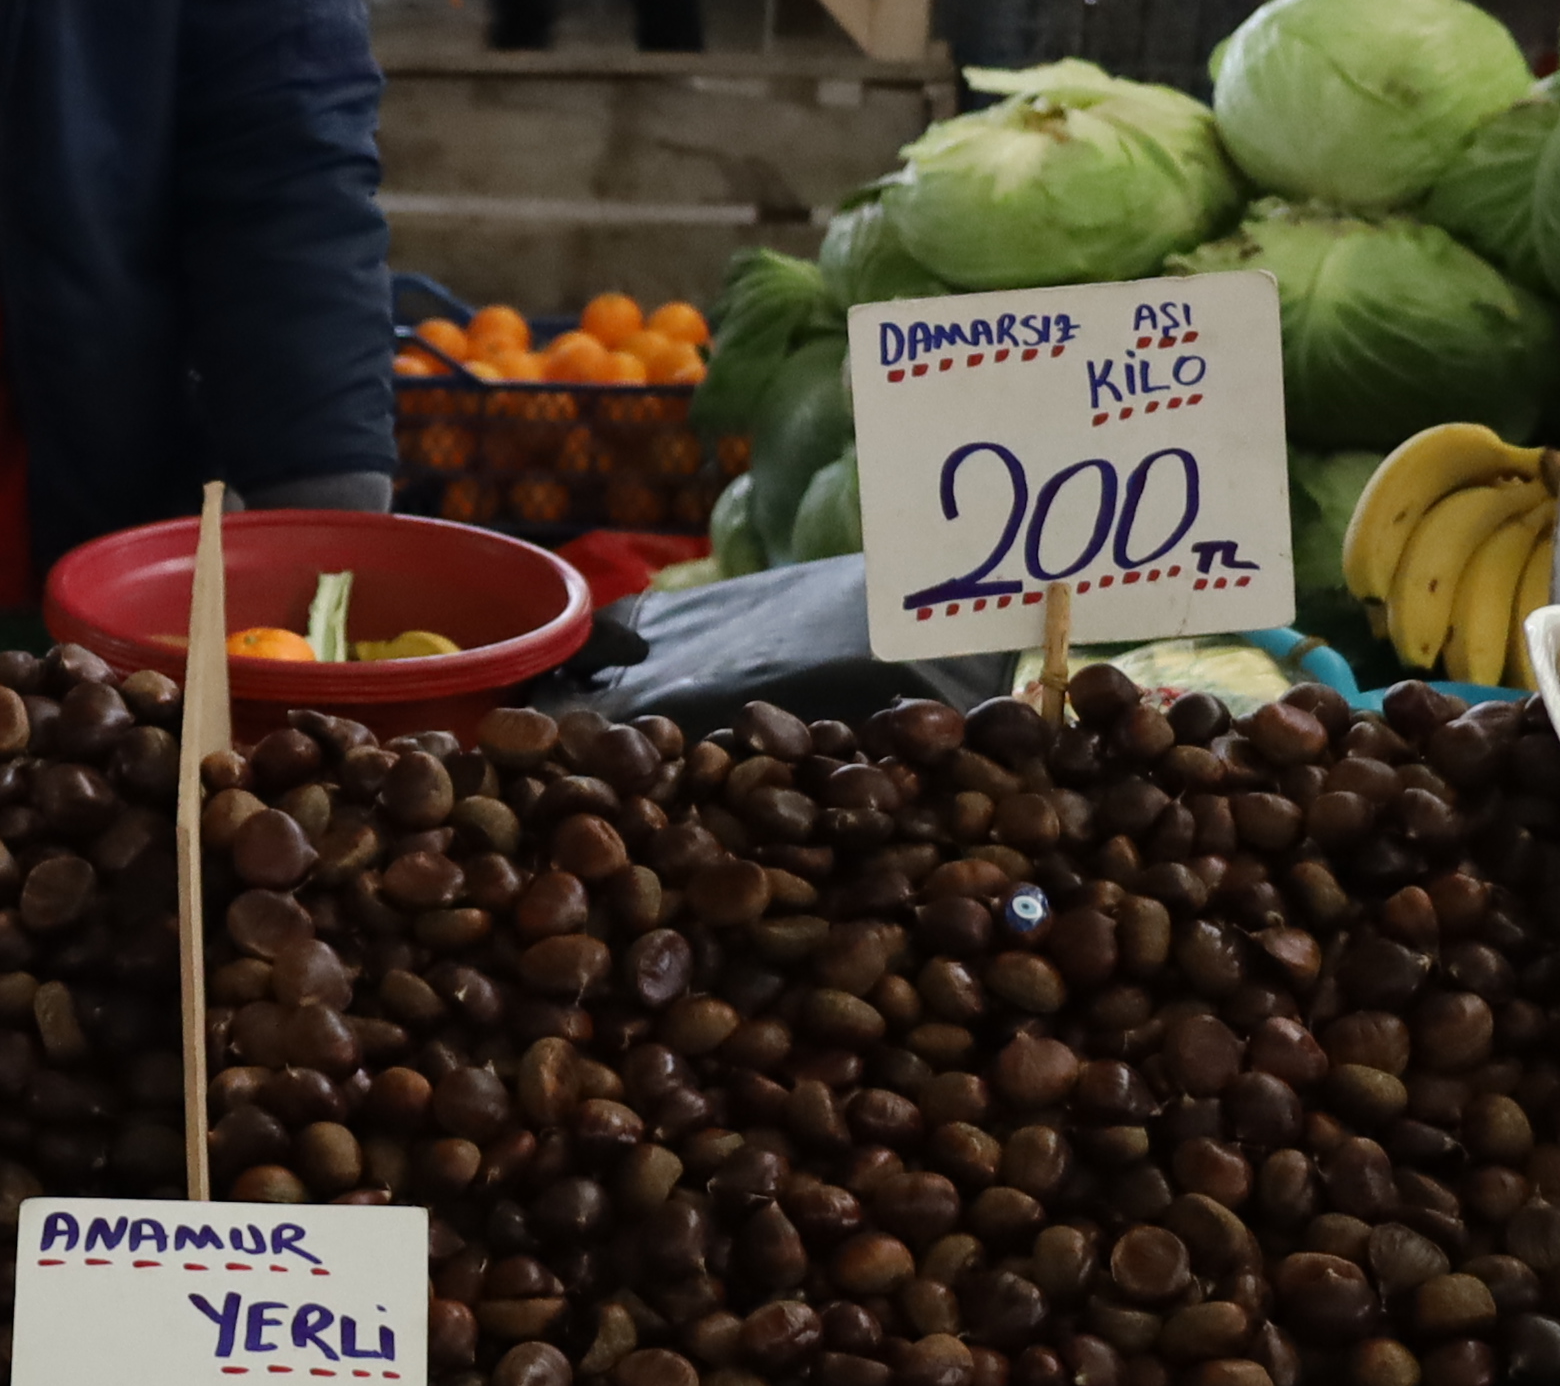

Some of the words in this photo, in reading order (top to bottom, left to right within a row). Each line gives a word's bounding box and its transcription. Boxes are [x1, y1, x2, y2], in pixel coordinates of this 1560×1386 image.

[880, 313, 1080, 365] DAMARSIZ
[1134, 303, 1191, 338] AŞI
[1087, 350, 1206, 409] KİLO
[904, 442, 1199, 610] 200
[40, 1212, 323, 1265] ANAMUR
[188, 1291, 396, 1362] YERLİ
